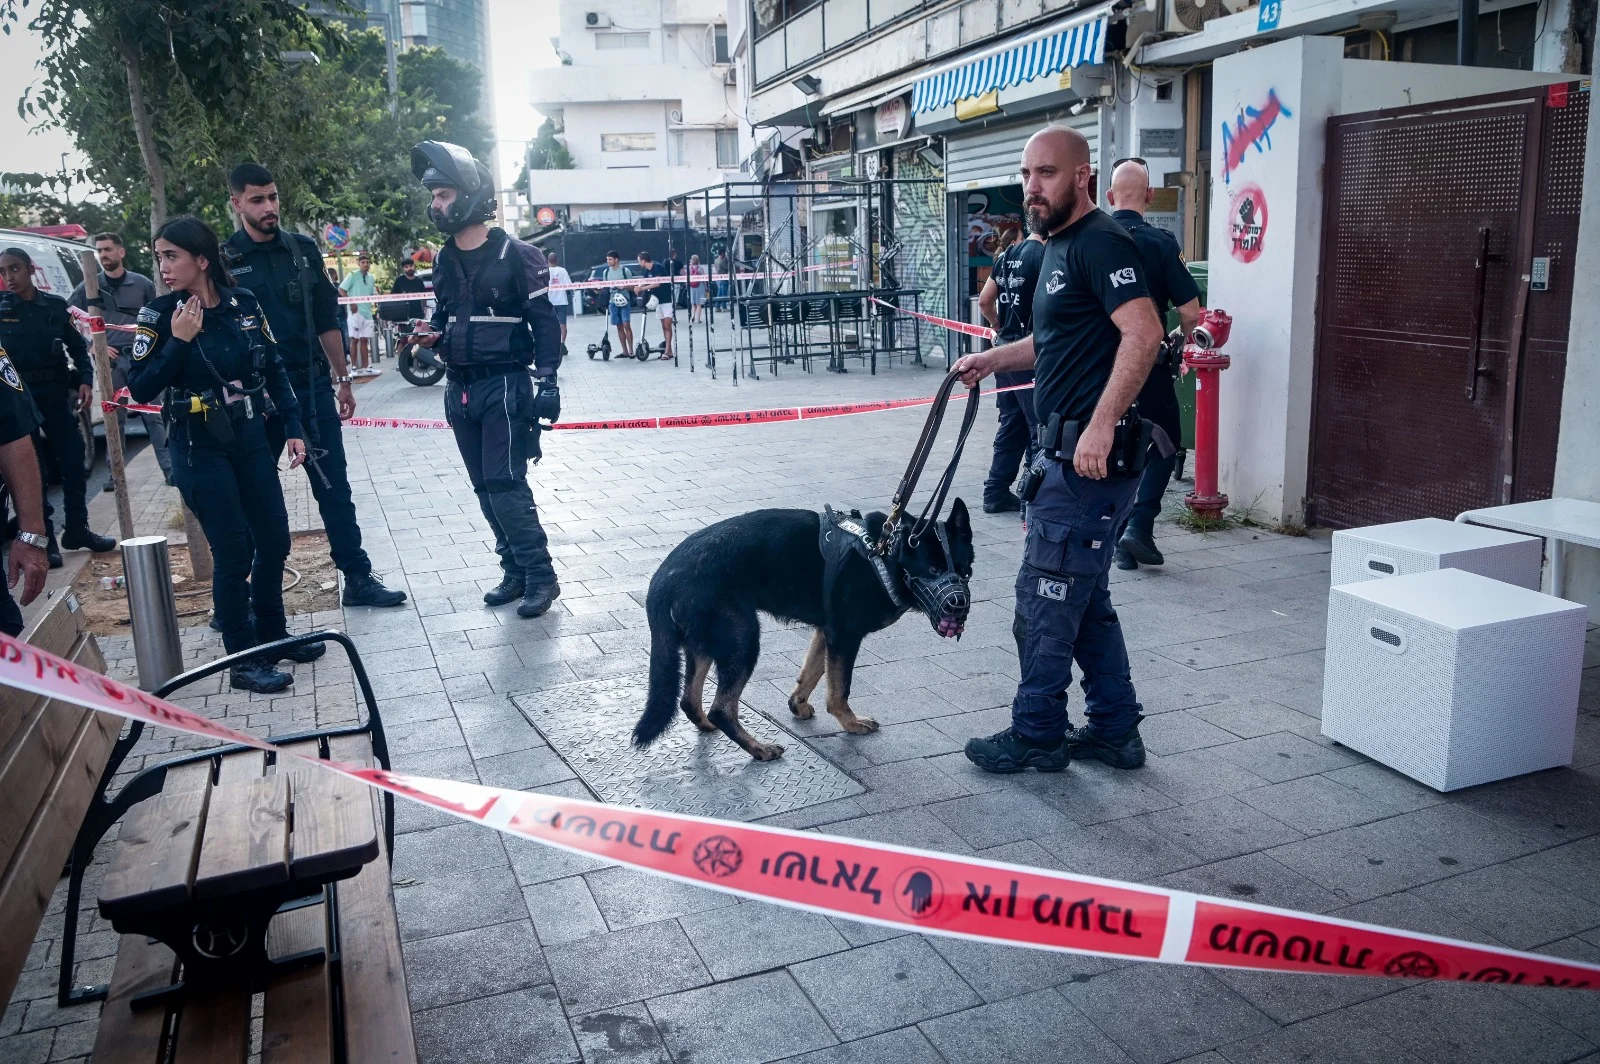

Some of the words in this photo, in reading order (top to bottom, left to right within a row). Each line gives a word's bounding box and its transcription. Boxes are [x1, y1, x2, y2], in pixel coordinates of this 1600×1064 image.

[1260, 2, 1279, 23] 43
[1108, 267, 1137, 289] K9
[1039, 578, 1066, 601] K9
[532, 806, 683, 856] משטרת
[759, 850, 884, 906] ישראל
[962, 880, 1019, 919] אין
[1031, 893, 1142, 939] מעבר
[1208, 922, 1374, 971] משטרת
